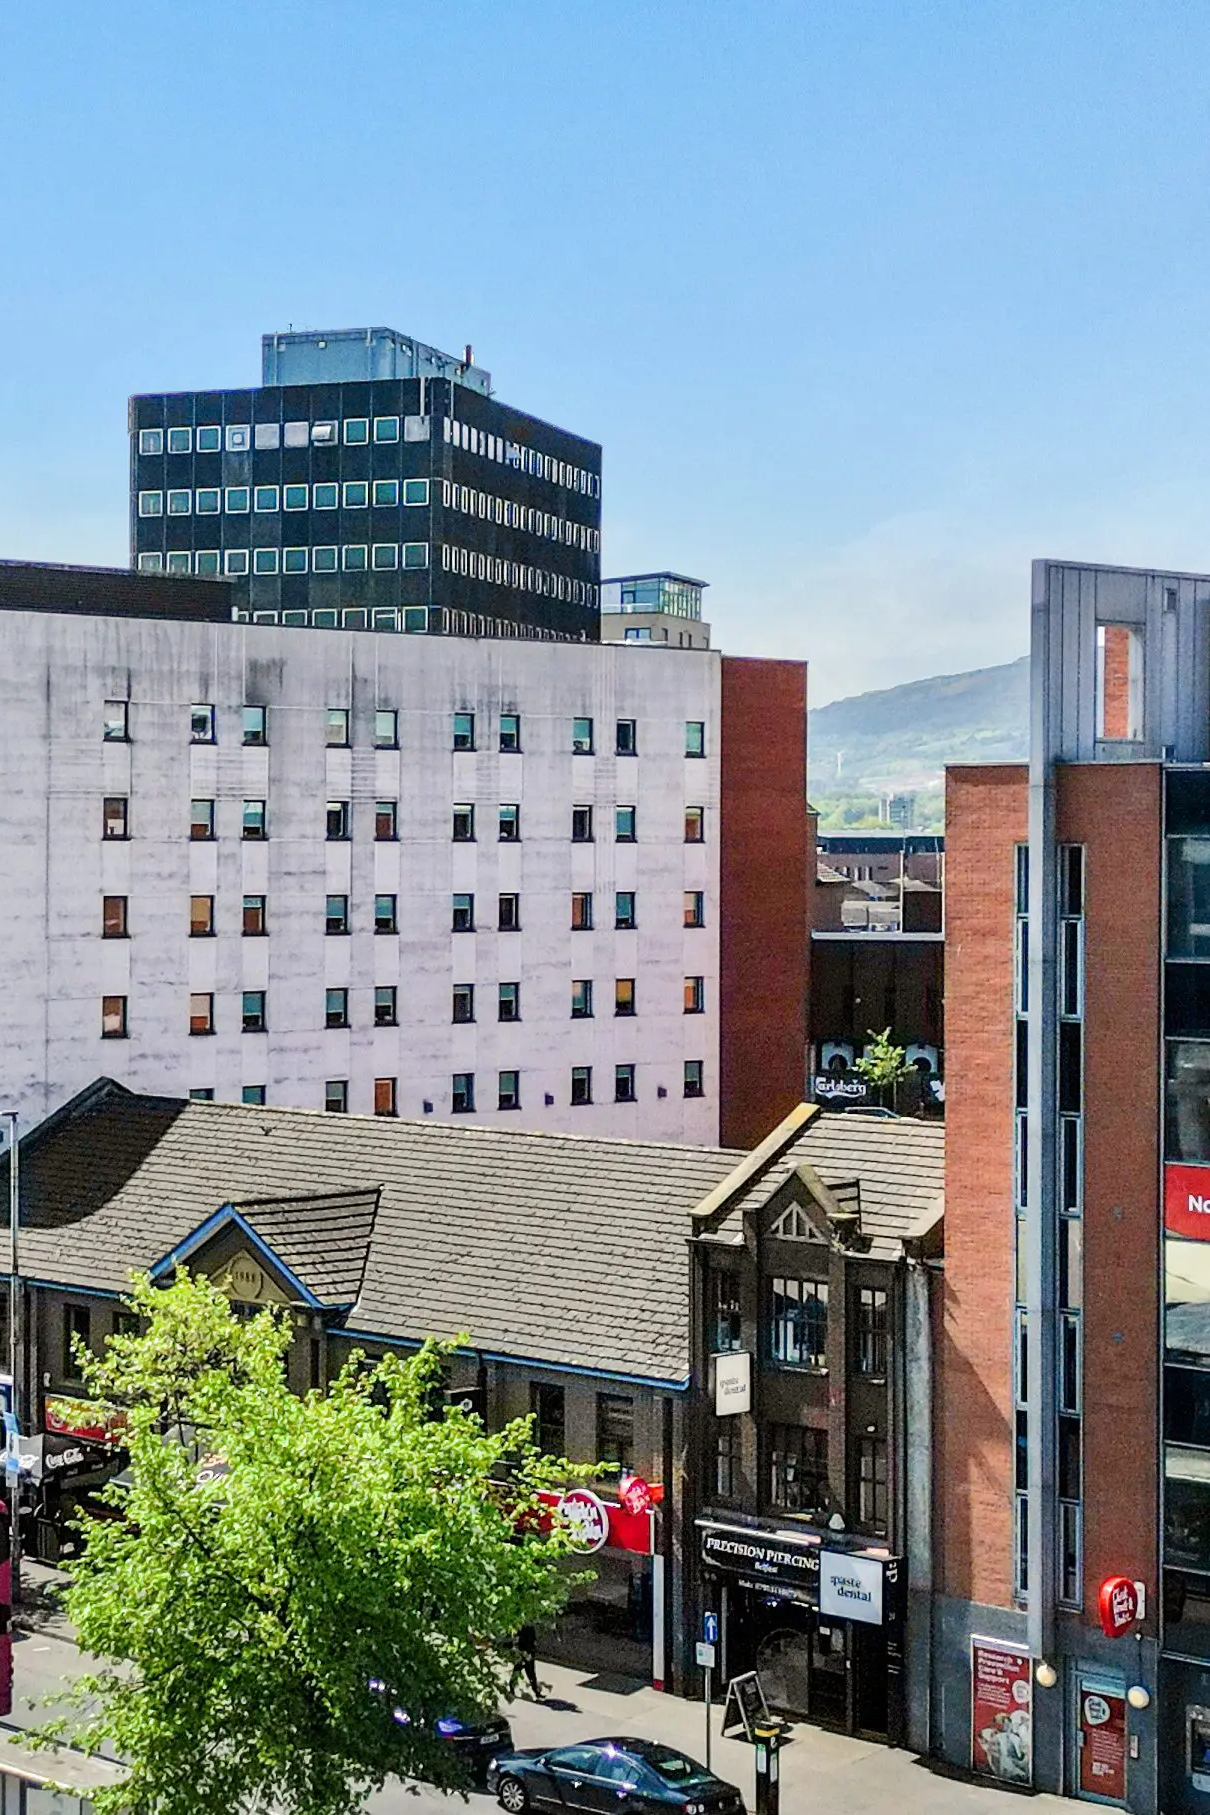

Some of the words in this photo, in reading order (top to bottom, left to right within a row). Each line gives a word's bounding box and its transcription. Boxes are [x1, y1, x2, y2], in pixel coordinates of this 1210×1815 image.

[814, 1077, 867, 1097] Carlsberg
[706, 1537, 765, 1560] PRECISION
[766, 1549, 820, 1571] PIERCING
[837, 1587, 871, 1603] dental
